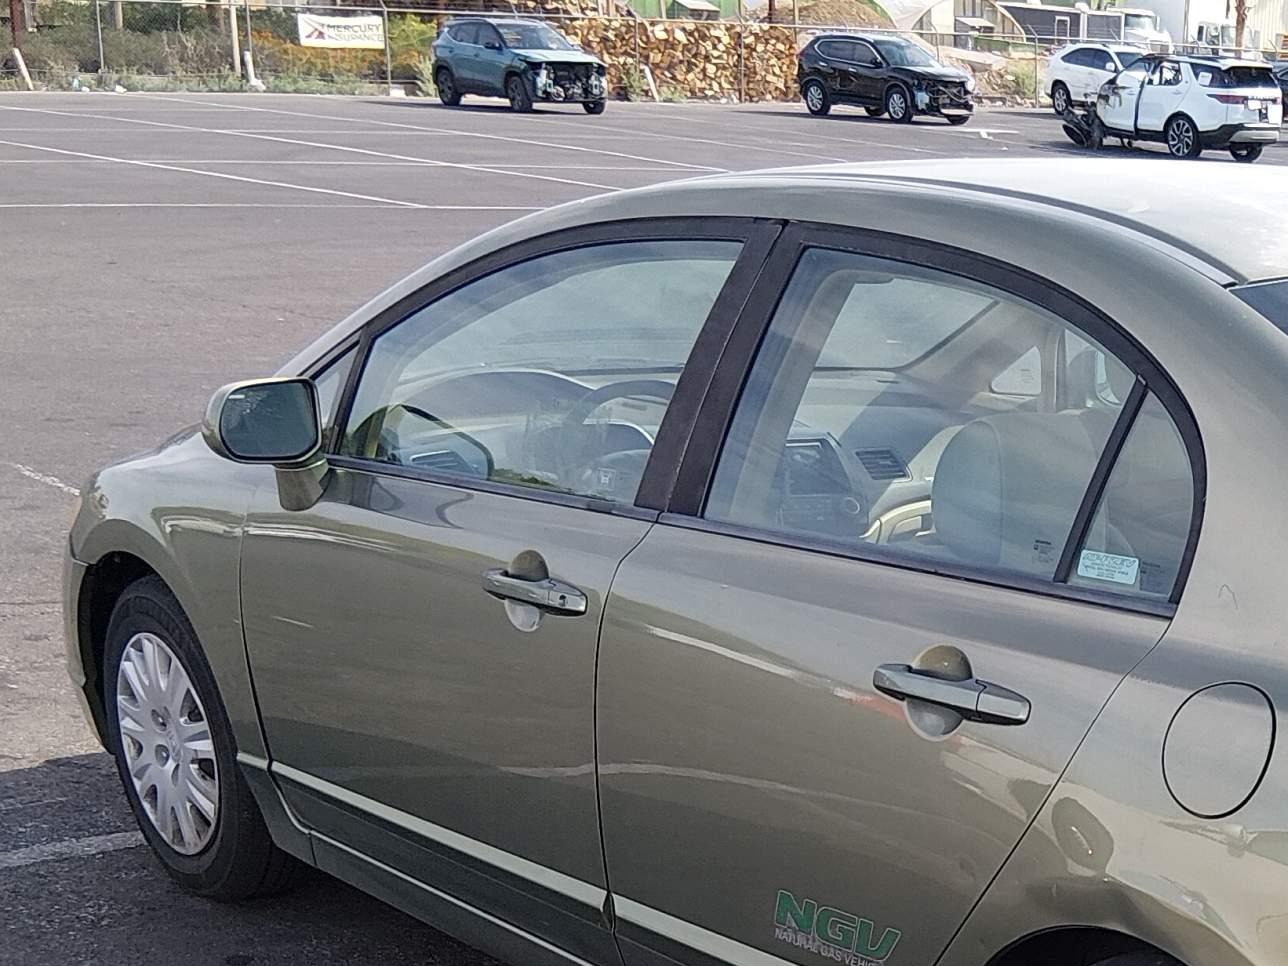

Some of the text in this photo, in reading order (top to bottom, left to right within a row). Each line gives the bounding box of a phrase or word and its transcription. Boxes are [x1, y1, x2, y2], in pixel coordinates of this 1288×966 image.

[327, 23, 382, 33] MERCURY
[774, 928, 819, 954] NATURAL
[820, 944, 842, 962] GAS
